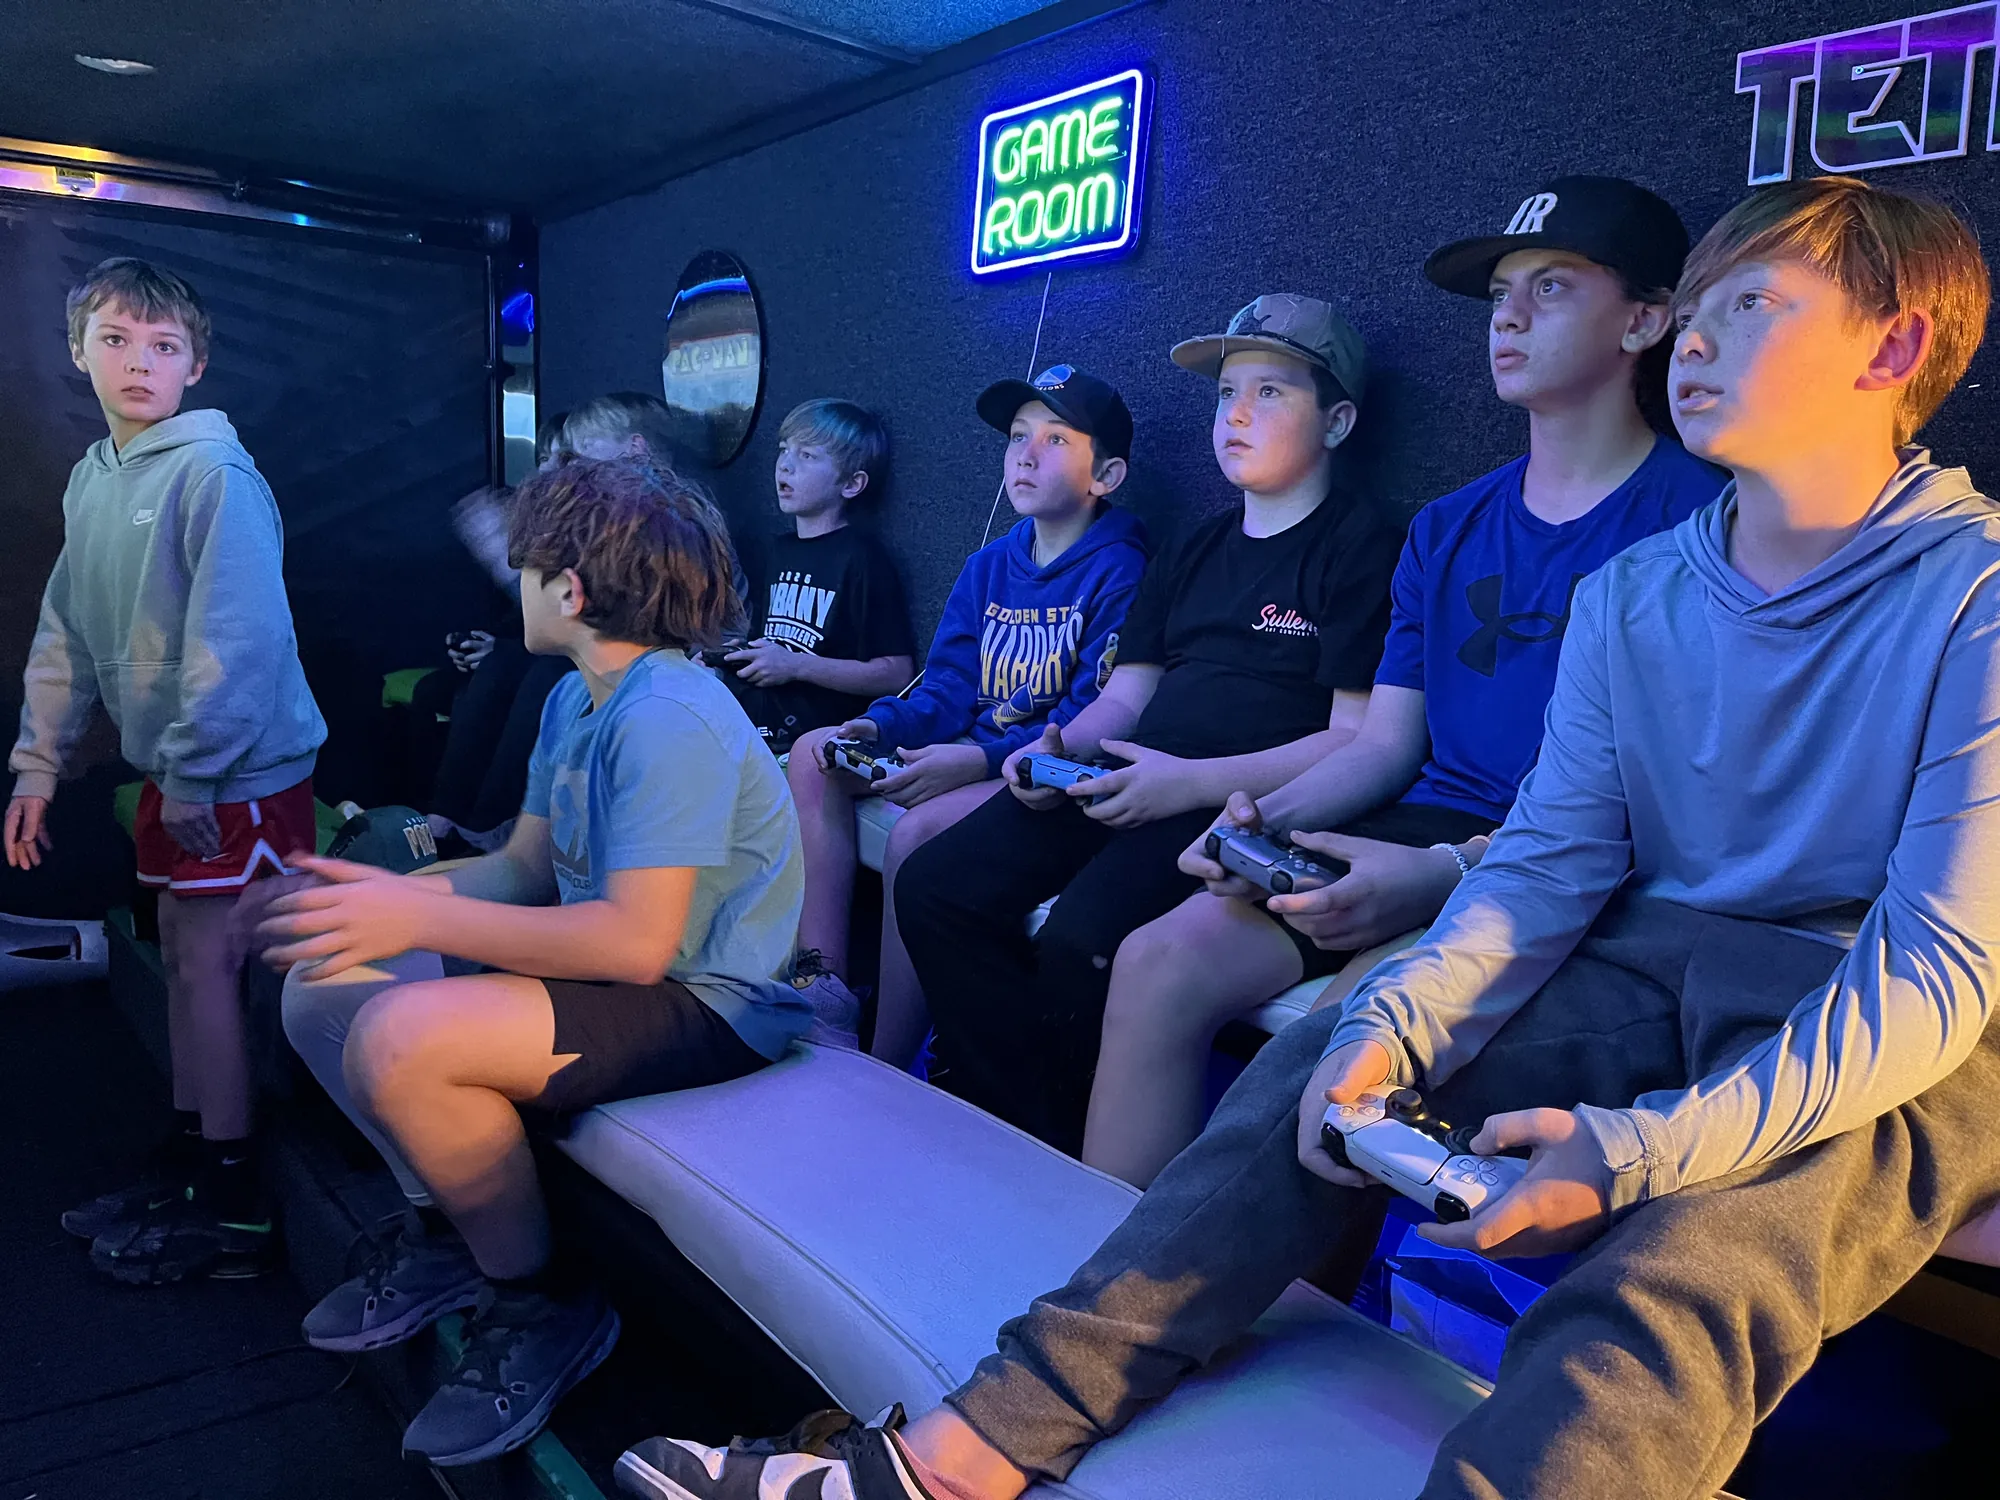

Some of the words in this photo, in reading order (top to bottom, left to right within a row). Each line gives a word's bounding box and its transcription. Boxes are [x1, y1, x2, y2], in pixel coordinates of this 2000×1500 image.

[1735, 0, 2000, 186] TET
[993, 96, 1124, 182] GAME
[982, 172, 1116, 255] ROOM
[768, 582, 836, 629] BANY
[1251, 604, 1312, 631] Sullen
